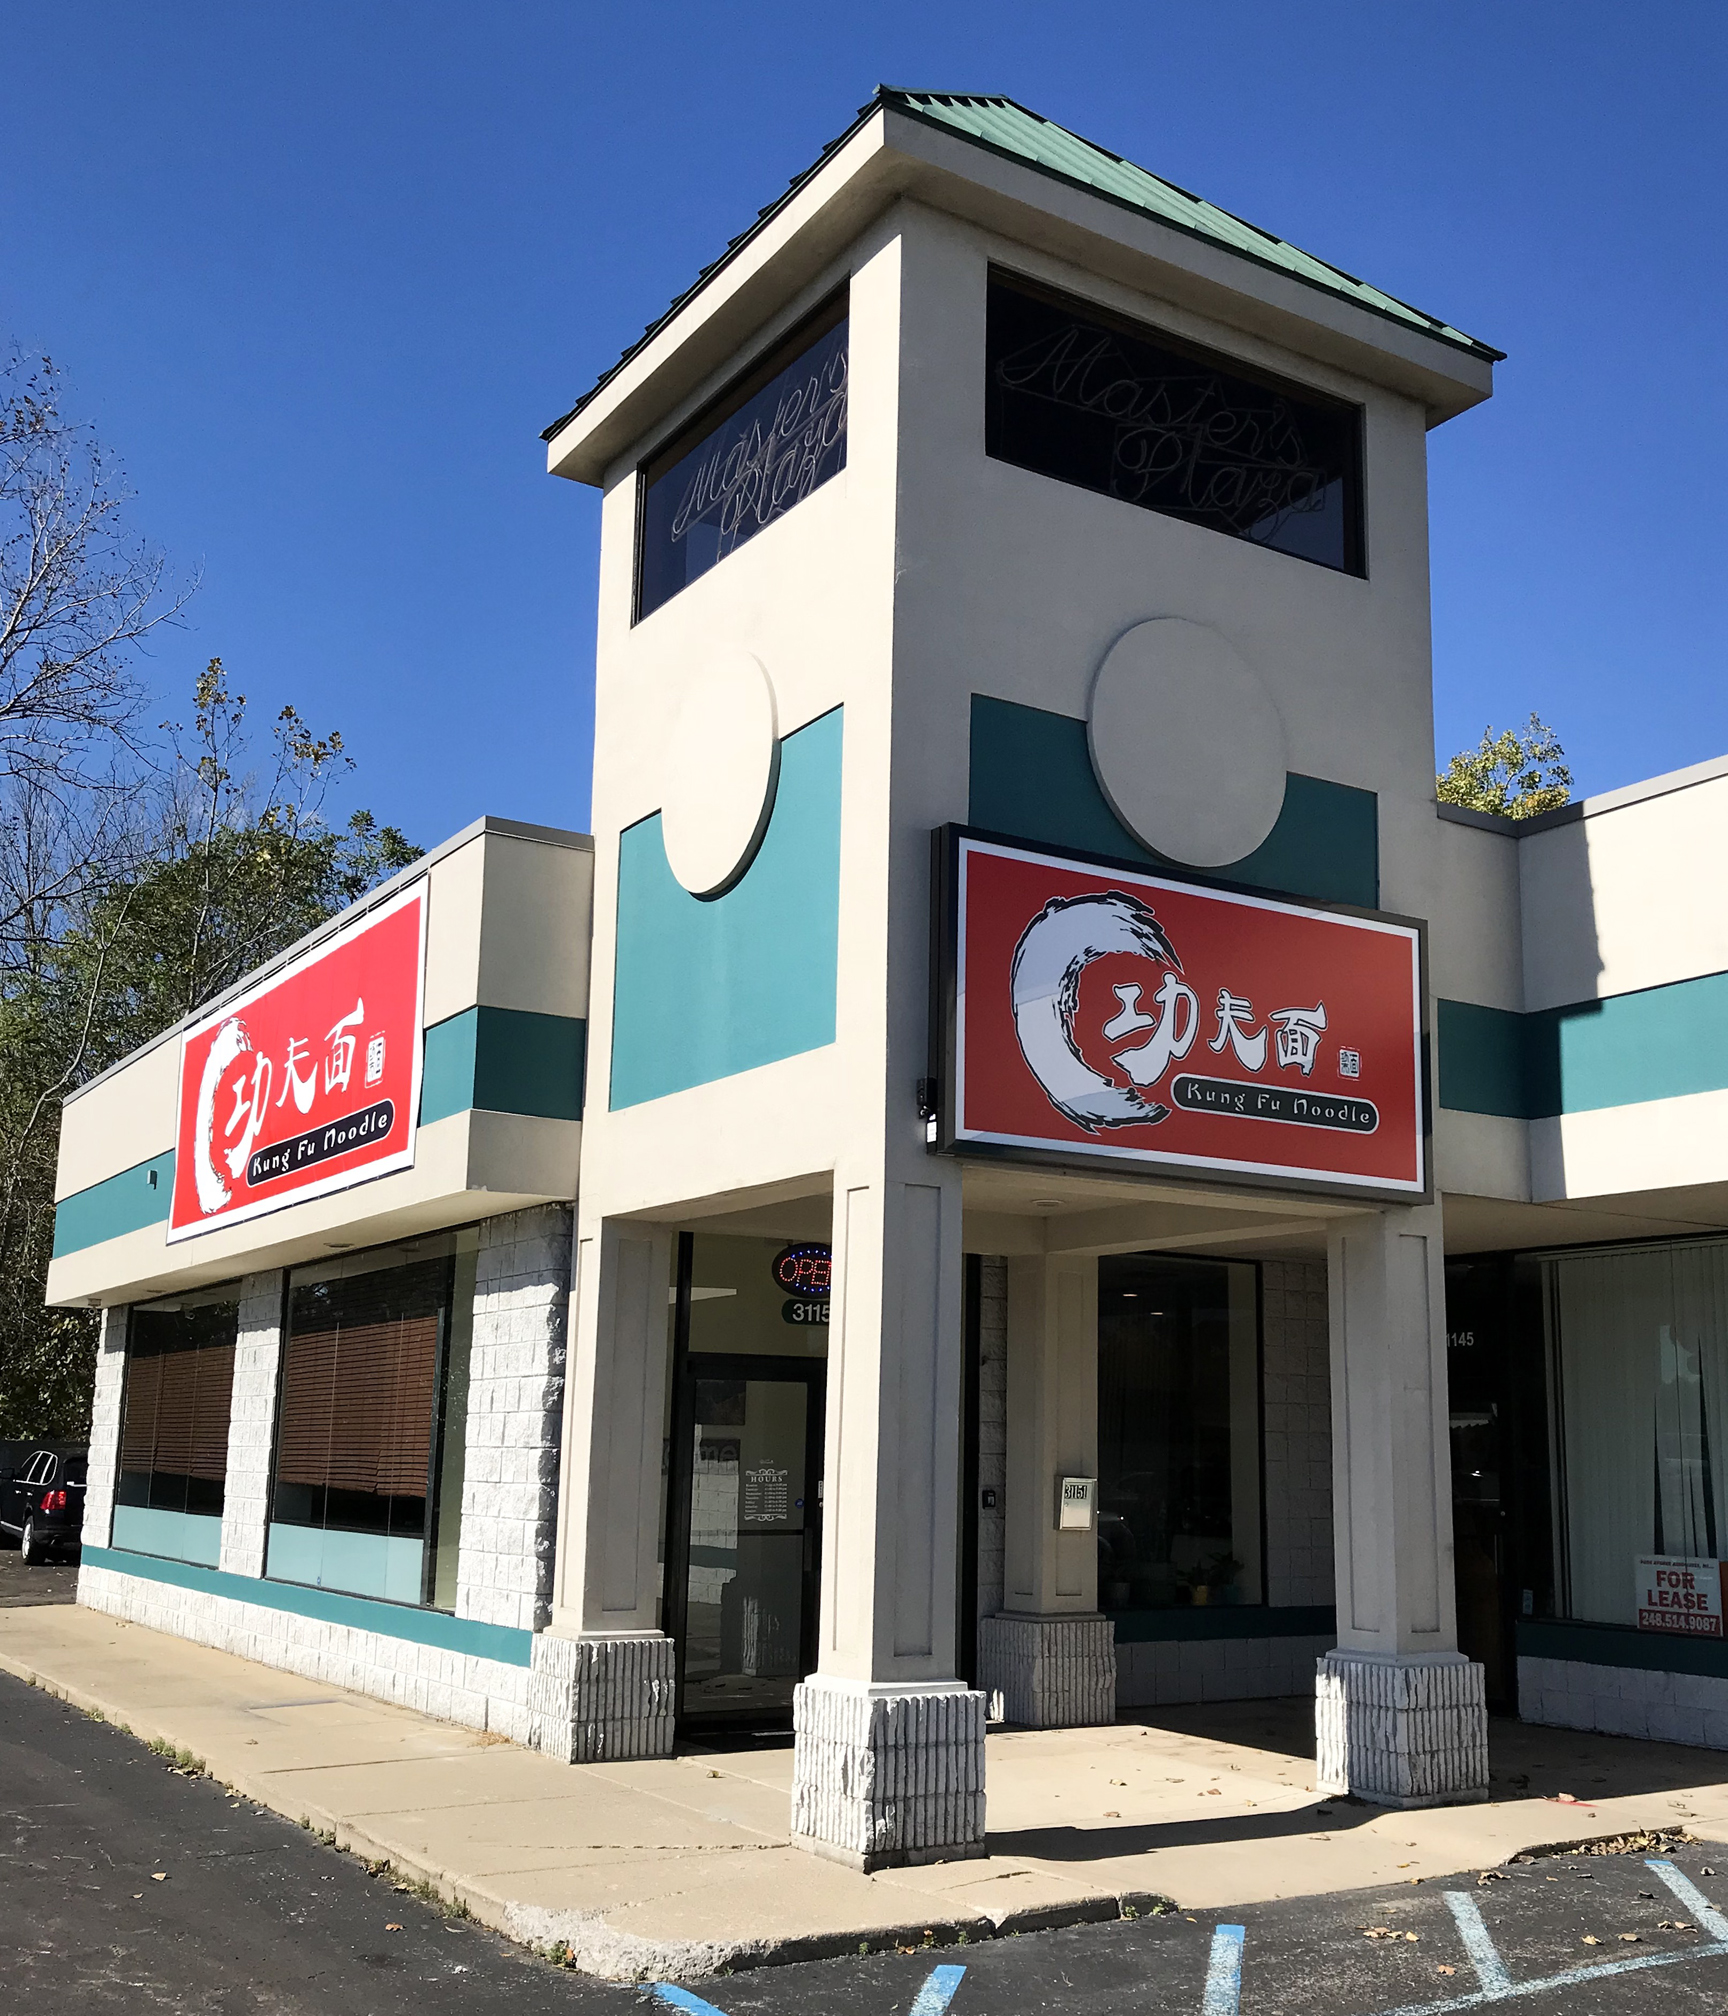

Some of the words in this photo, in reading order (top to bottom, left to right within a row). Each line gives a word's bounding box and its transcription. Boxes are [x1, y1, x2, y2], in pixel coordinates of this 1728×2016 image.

[1187, 1082, 1246, 1112] Kung
[1257, 1093, 1280, 1111] Fu
[1293, 1098, 1370, 1124] Noodle
[252, 1148, 291, 1177] Kung
[297, 1139, 316, 1161] Fu
[323, 1111, 388, 1151] Noodle
[750, 1475, 783, 1483] HOURS
[1065, 1484, 1088, 1500] 31151
[1656, 1570, 1695, 1589] FOR
[1647, 1589, 1709, 1611] LEASE
[1641, 1611, 1717, 1632] 248.514.9087
